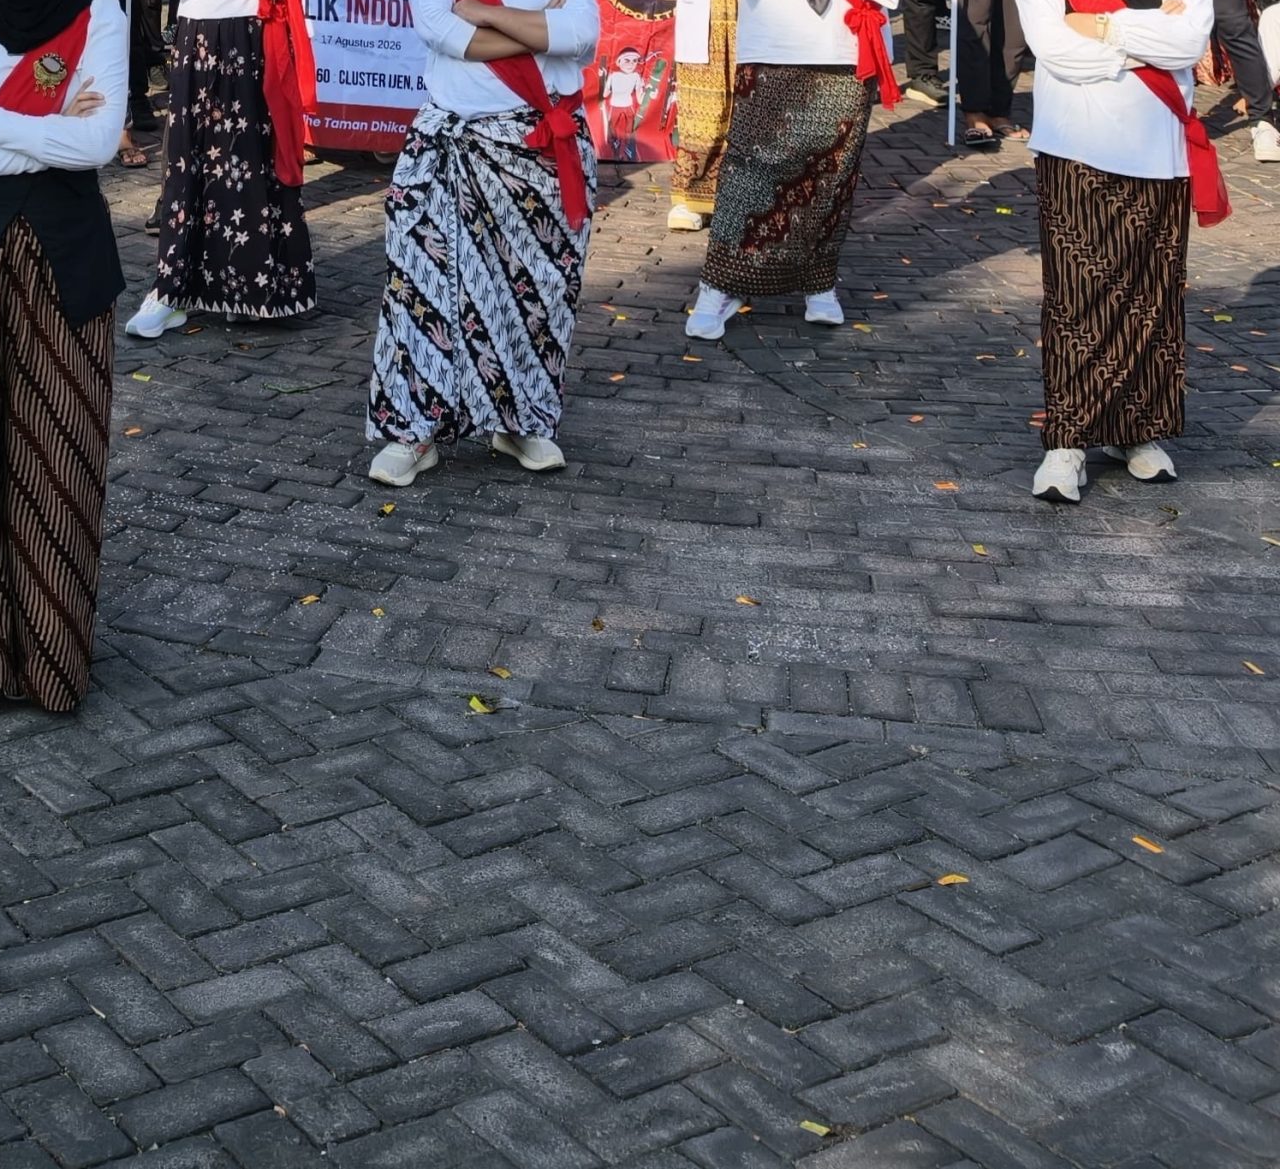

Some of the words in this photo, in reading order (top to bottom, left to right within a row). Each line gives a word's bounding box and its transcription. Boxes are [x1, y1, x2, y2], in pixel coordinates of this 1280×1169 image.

[321, 35, 332, 45] 17
[335, 36, 375, 48] Agustus
[377, 39, 401, 50] 2026
[316, 68, 330, 83] 60
[338, 69, 385, 88] CLUSTER
[324, 117, 368, 130] Taman
[371, 121, 407, 133] Dhika
